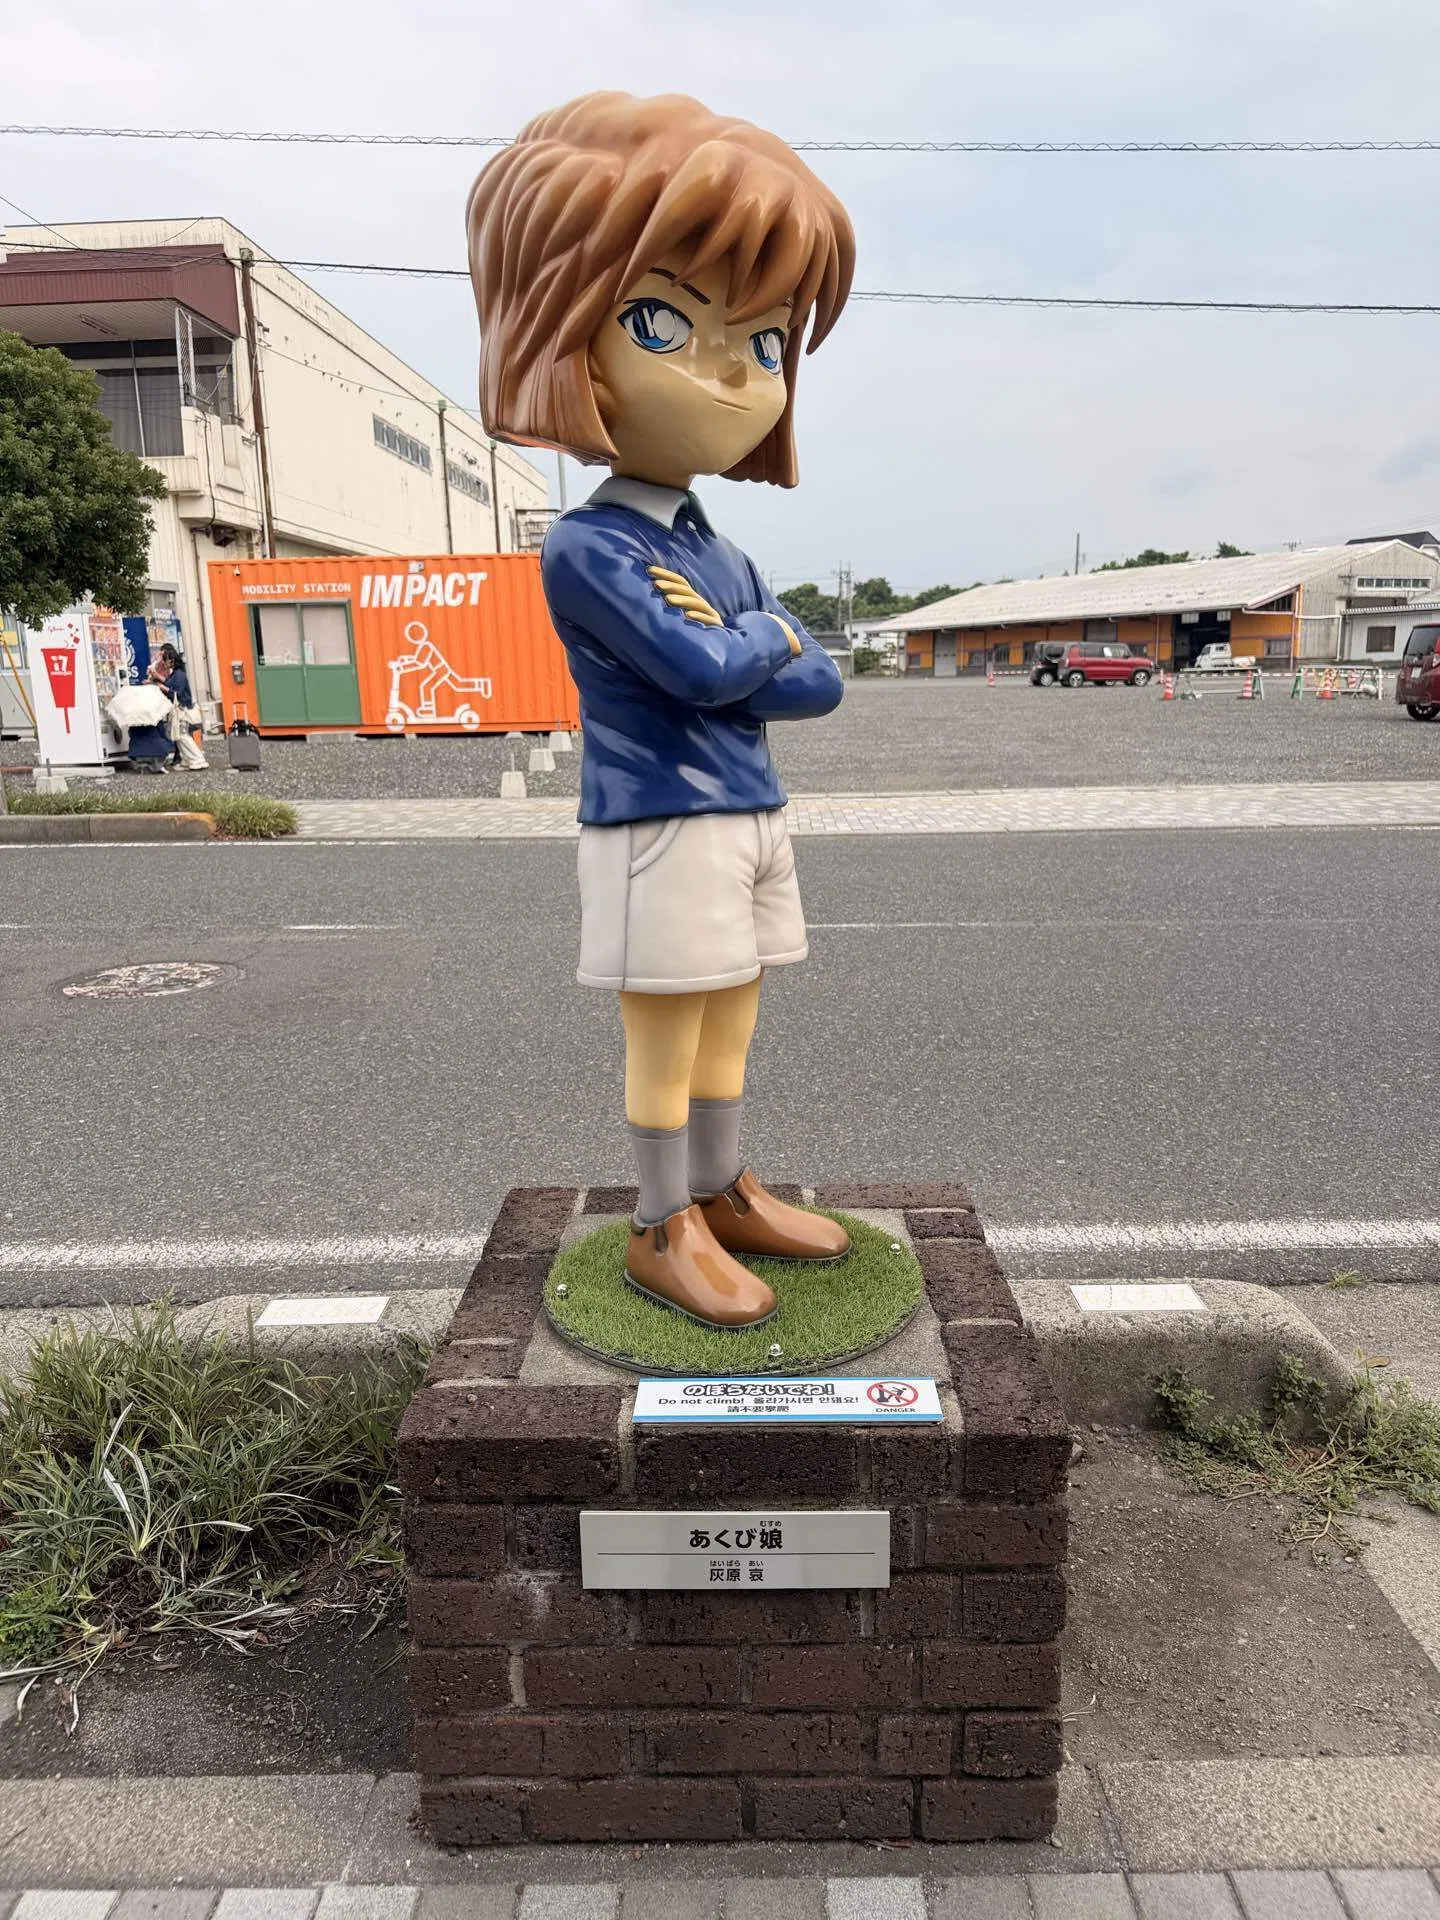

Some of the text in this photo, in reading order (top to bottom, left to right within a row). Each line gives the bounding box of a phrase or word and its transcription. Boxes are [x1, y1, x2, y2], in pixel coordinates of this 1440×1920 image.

[242, 583, 351, 594] MOBILITY STATION
[359, 572, 487, 608] IMPACT
[689, 1528, 783, 1549] あくび娘
[709, 1568, 764, 1581] 灰原 哀
